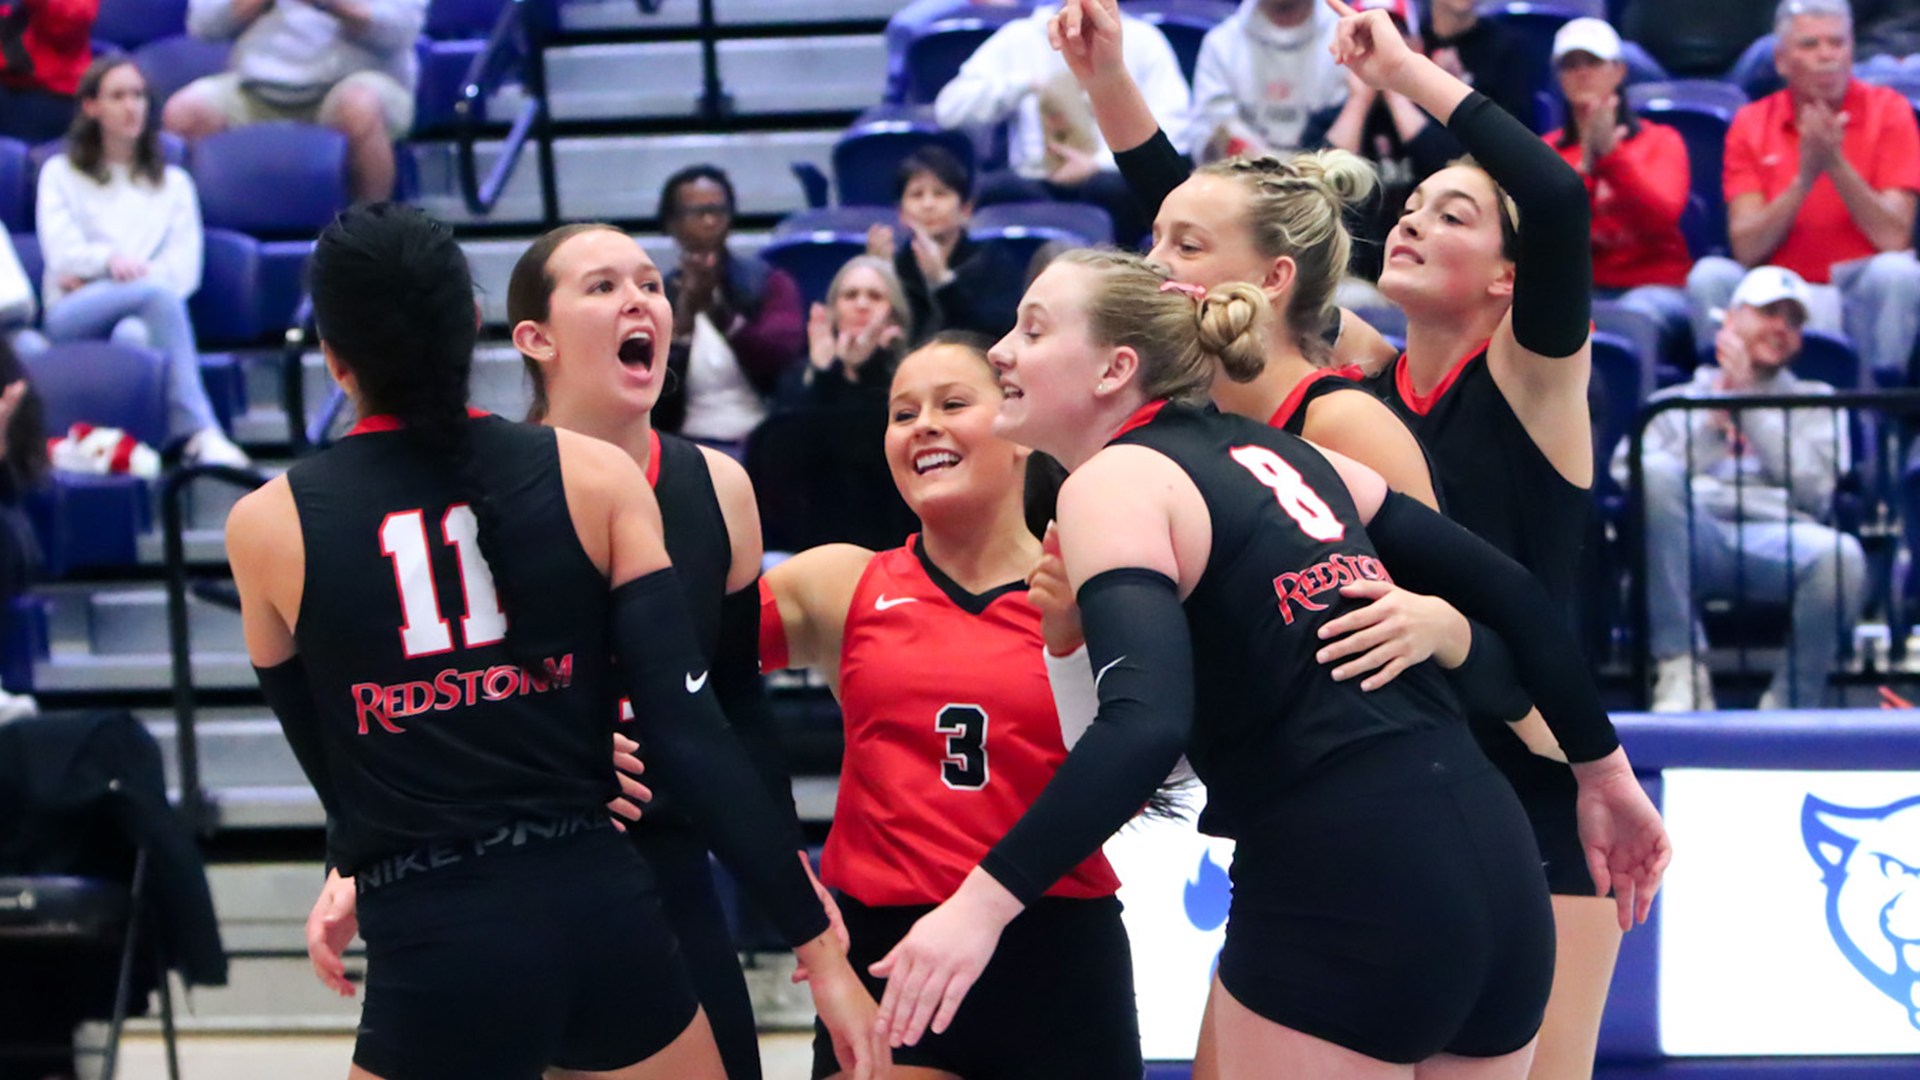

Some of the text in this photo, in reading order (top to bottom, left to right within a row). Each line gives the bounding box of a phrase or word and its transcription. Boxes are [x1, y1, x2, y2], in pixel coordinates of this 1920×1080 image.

[1229, 444, 1346, 543] 8
[378, 502, 509, 660] 11
[935, 703, 989, 791] 3
[358, 845, 461, 894] NIKE
